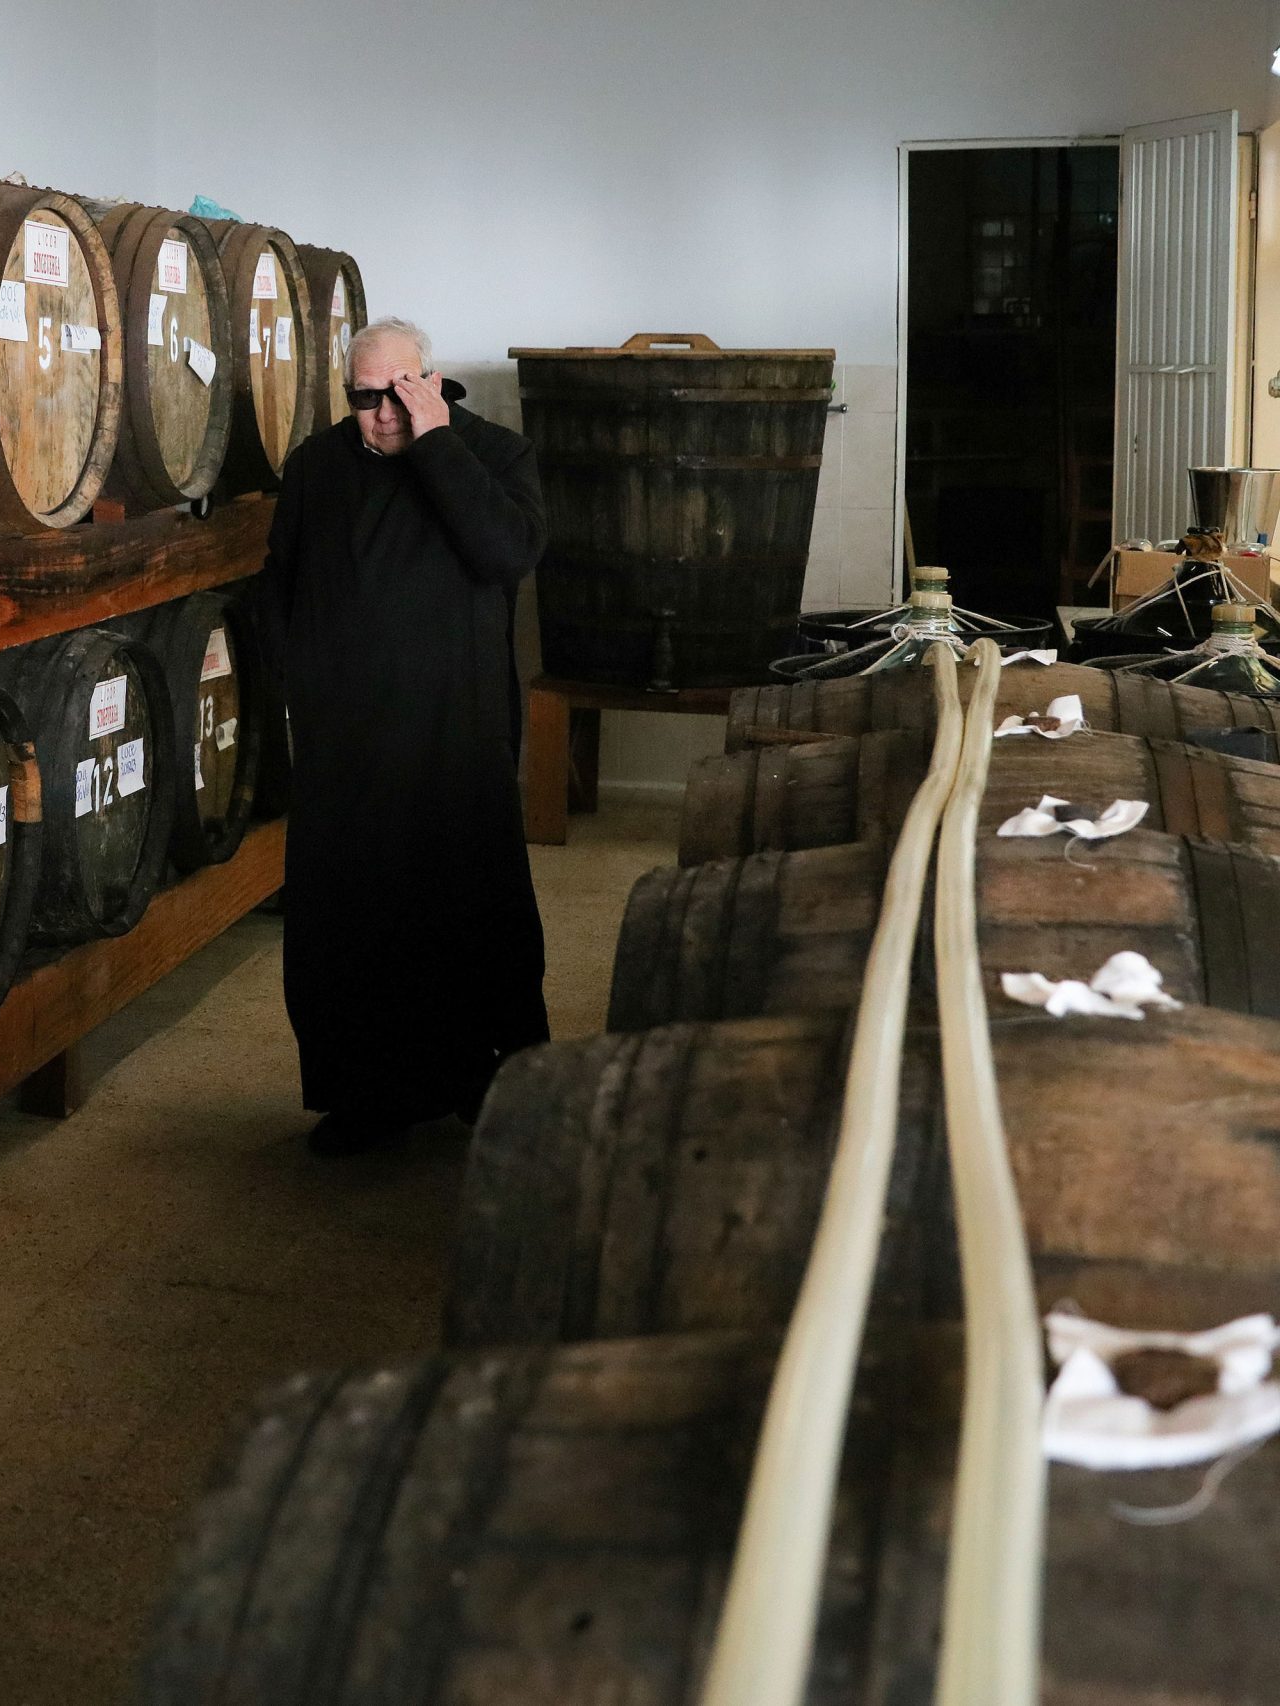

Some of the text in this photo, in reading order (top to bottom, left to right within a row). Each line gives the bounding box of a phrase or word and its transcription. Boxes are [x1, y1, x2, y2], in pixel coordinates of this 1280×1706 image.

[38, 317, 52, 370] 5
[170, 317, 178, 363] 6
[263, 327, 271, 368] 7
[333, 334, 339, 368] 8
[199, 695, 213, 741] 13
[93, 756, 113, 814] 12
